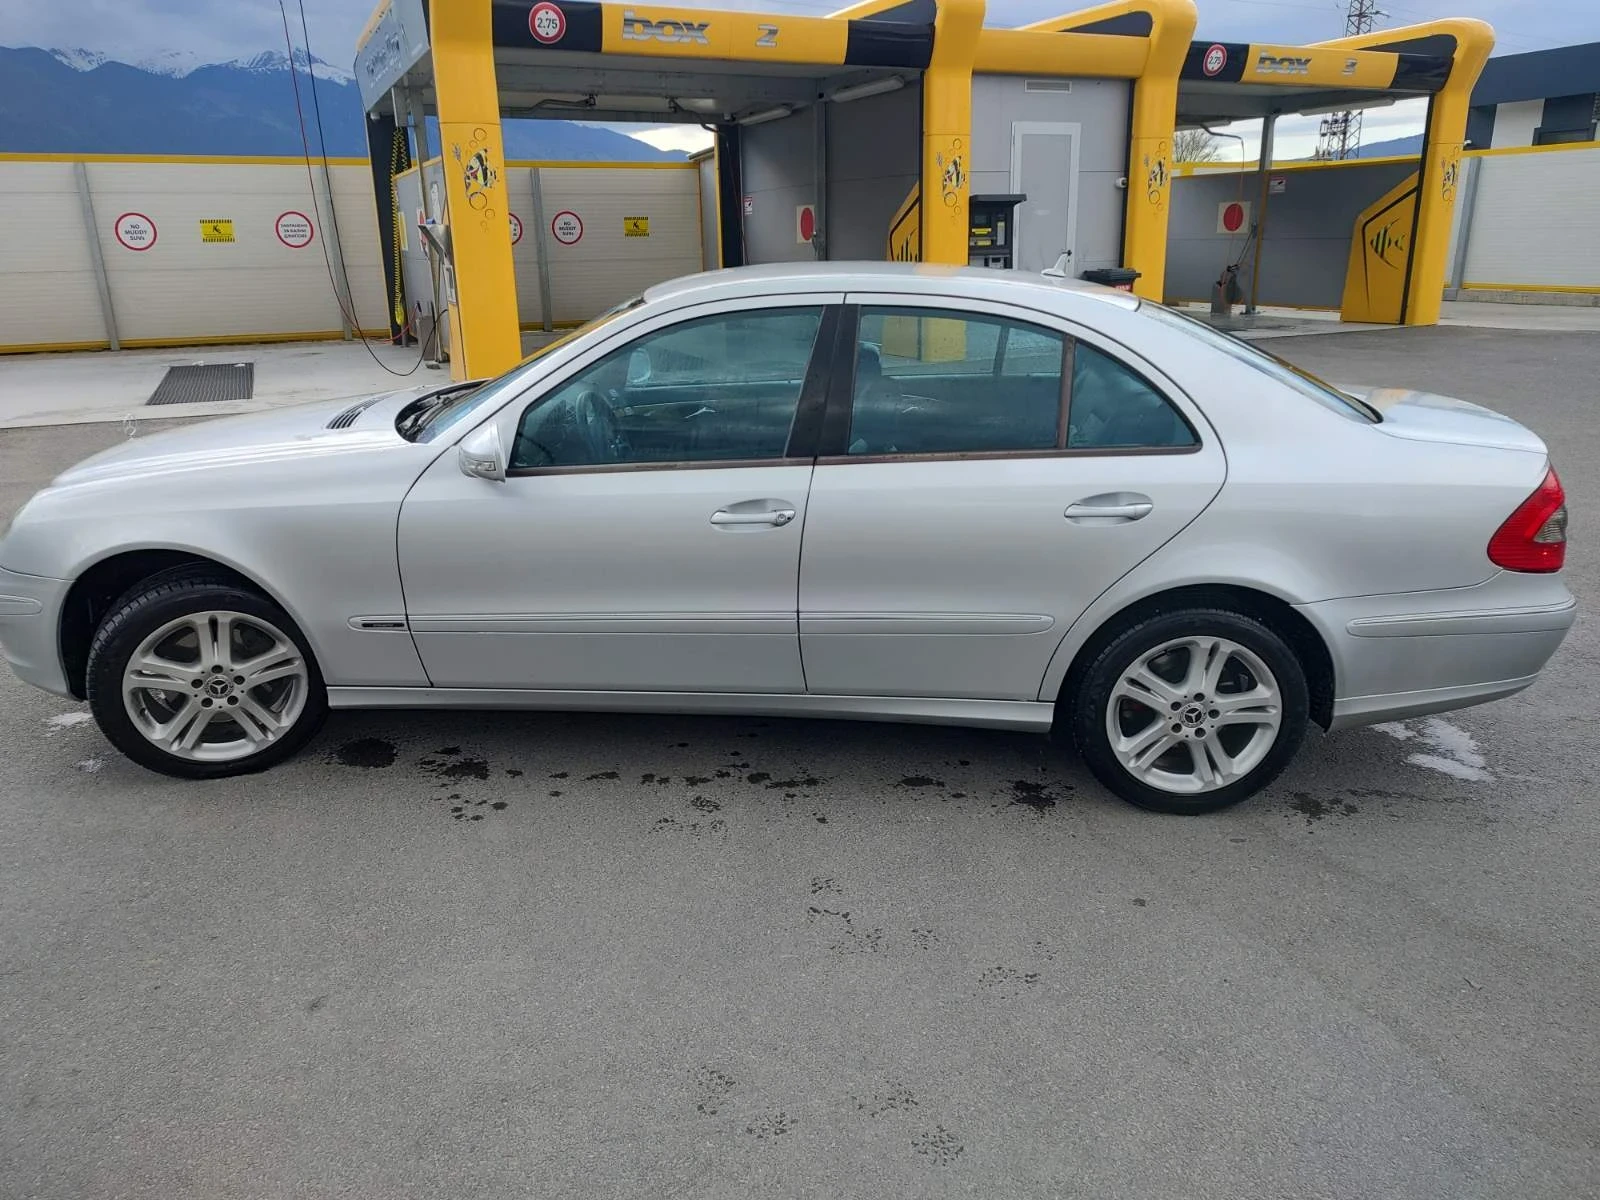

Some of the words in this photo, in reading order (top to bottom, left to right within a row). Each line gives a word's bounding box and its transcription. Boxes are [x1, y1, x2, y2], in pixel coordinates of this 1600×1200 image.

[537, 17, 558, 29] 2.75
[622, 9, 709, 45] box
[1208, 55, 1222, 65] 2.75
[1256, 49, 1312, 74] box
